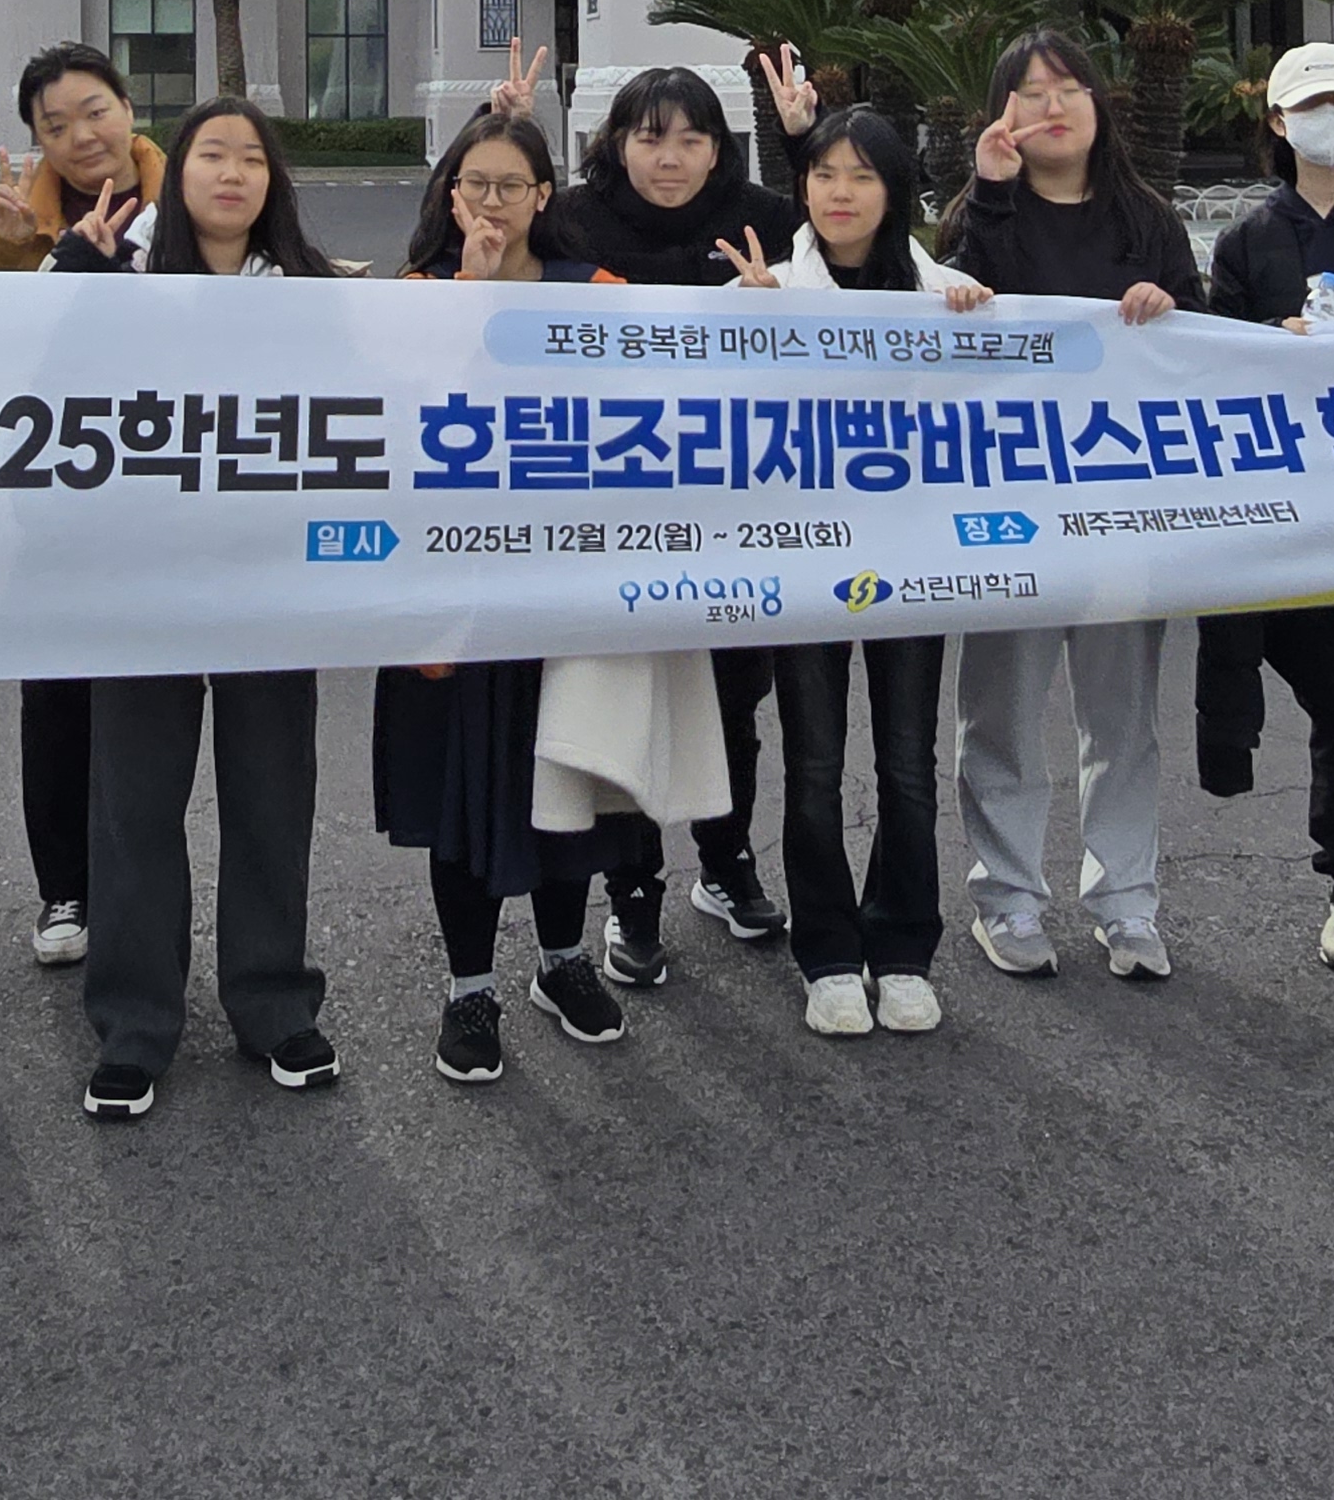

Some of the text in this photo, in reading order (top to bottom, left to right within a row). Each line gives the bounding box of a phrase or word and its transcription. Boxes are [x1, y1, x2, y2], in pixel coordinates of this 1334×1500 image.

[544, 323, 1055, 365] 포항 융복합 마이스 인재 양성 프로그램
[413, 391, 1306, 493] 호텔조리제빵바리스타과
[425, 523, 533, 555] 2025년
[544, 523, 607, 554] 12월
[616, 520, 703, 554] 22(월)
[737, 519, 852, 551] 23일(화)
[1059, 500, 1300, 538] 제주국제컨벤션센터
[898, 571, 1039, 604] 선린대학교
[705, 604, 757, 623] 포항시
